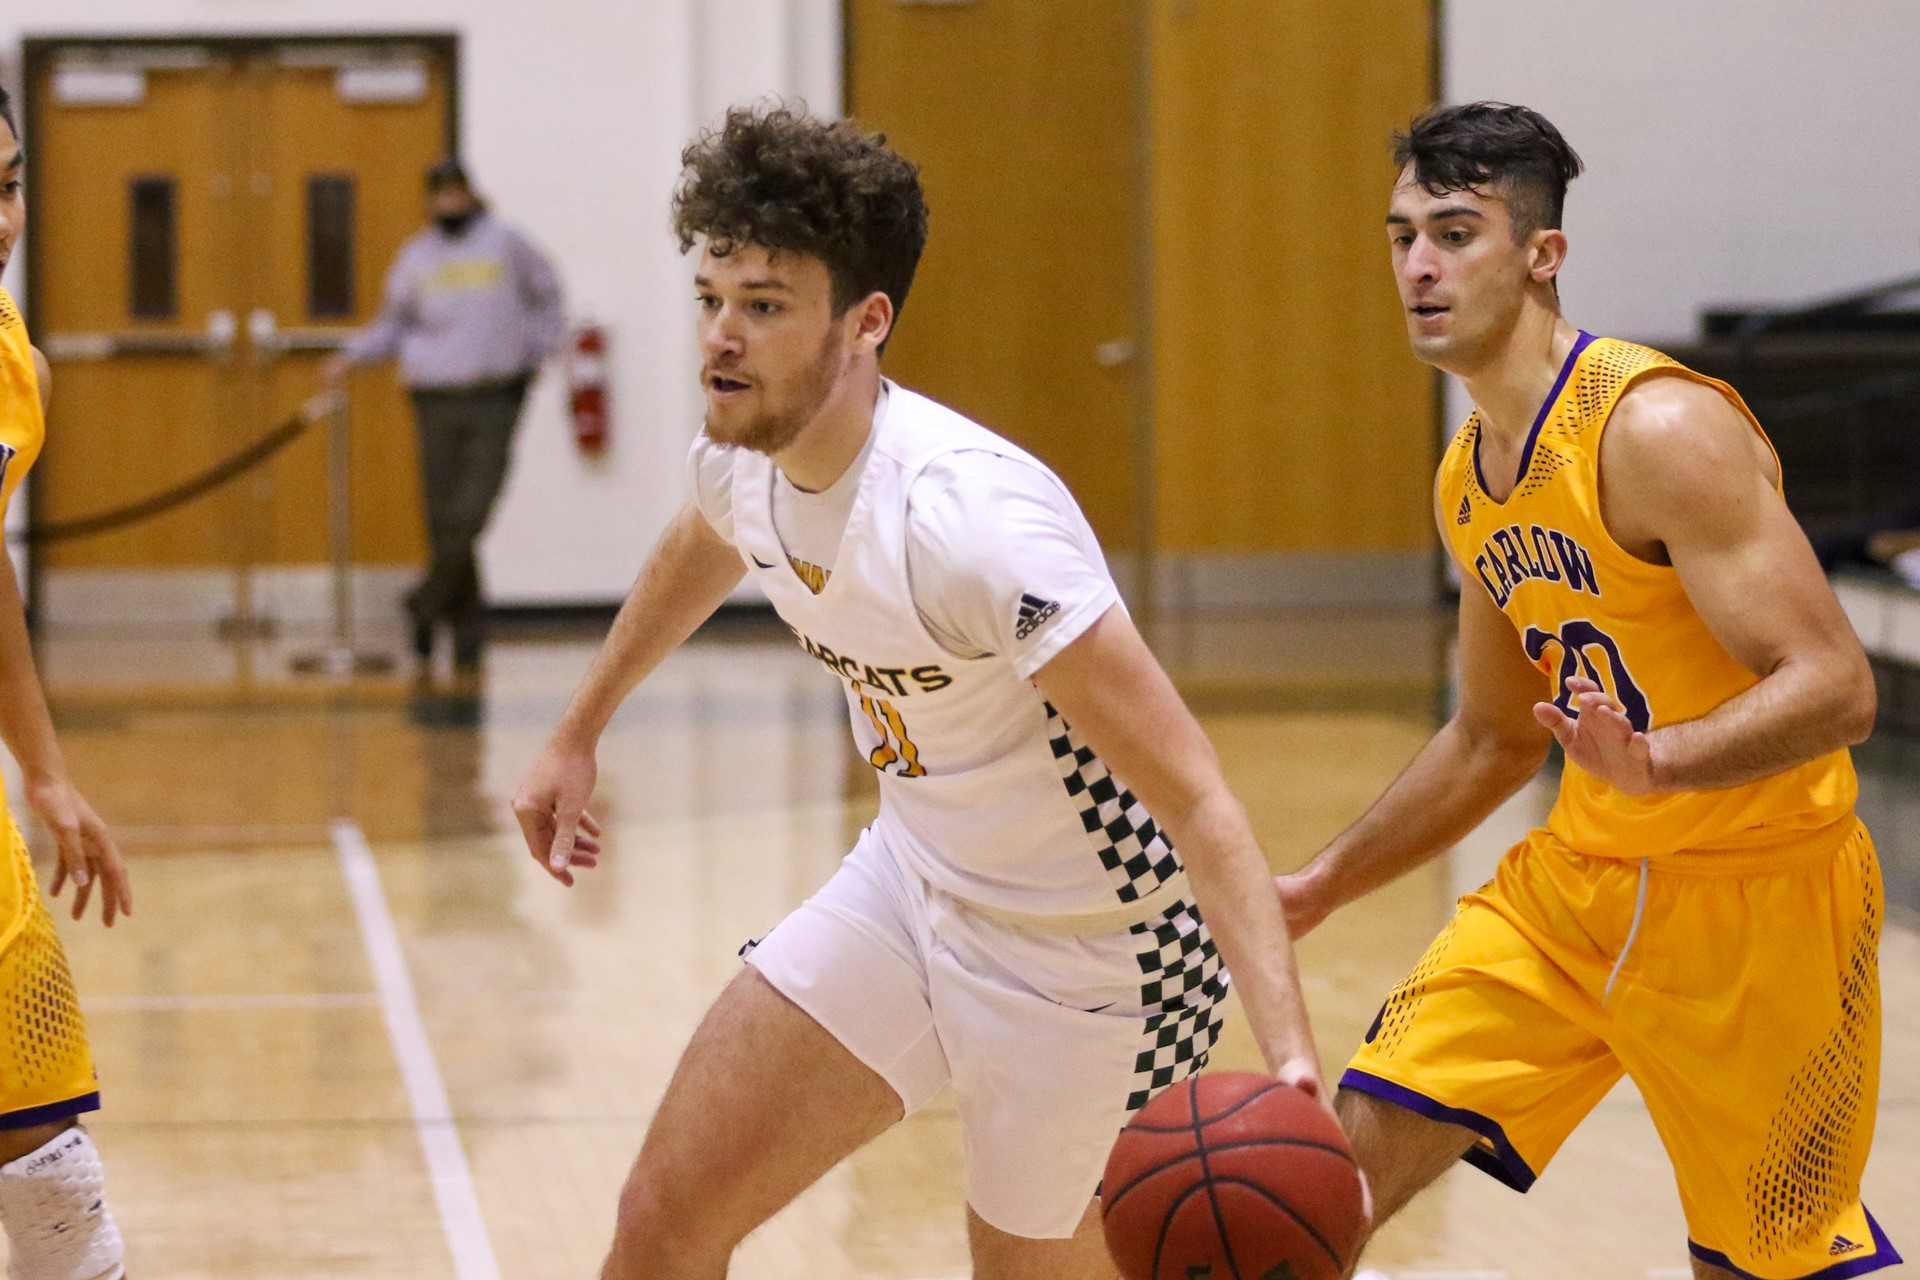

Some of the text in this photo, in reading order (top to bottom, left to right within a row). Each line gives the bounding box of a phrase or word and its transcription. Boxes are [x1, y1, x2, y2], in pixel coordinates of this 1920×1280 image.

[1475, 524, 1601, 609] CARLOW
[1016, 601, 1061, 640] adidas
[1522, 619, 1651, 733] 20
